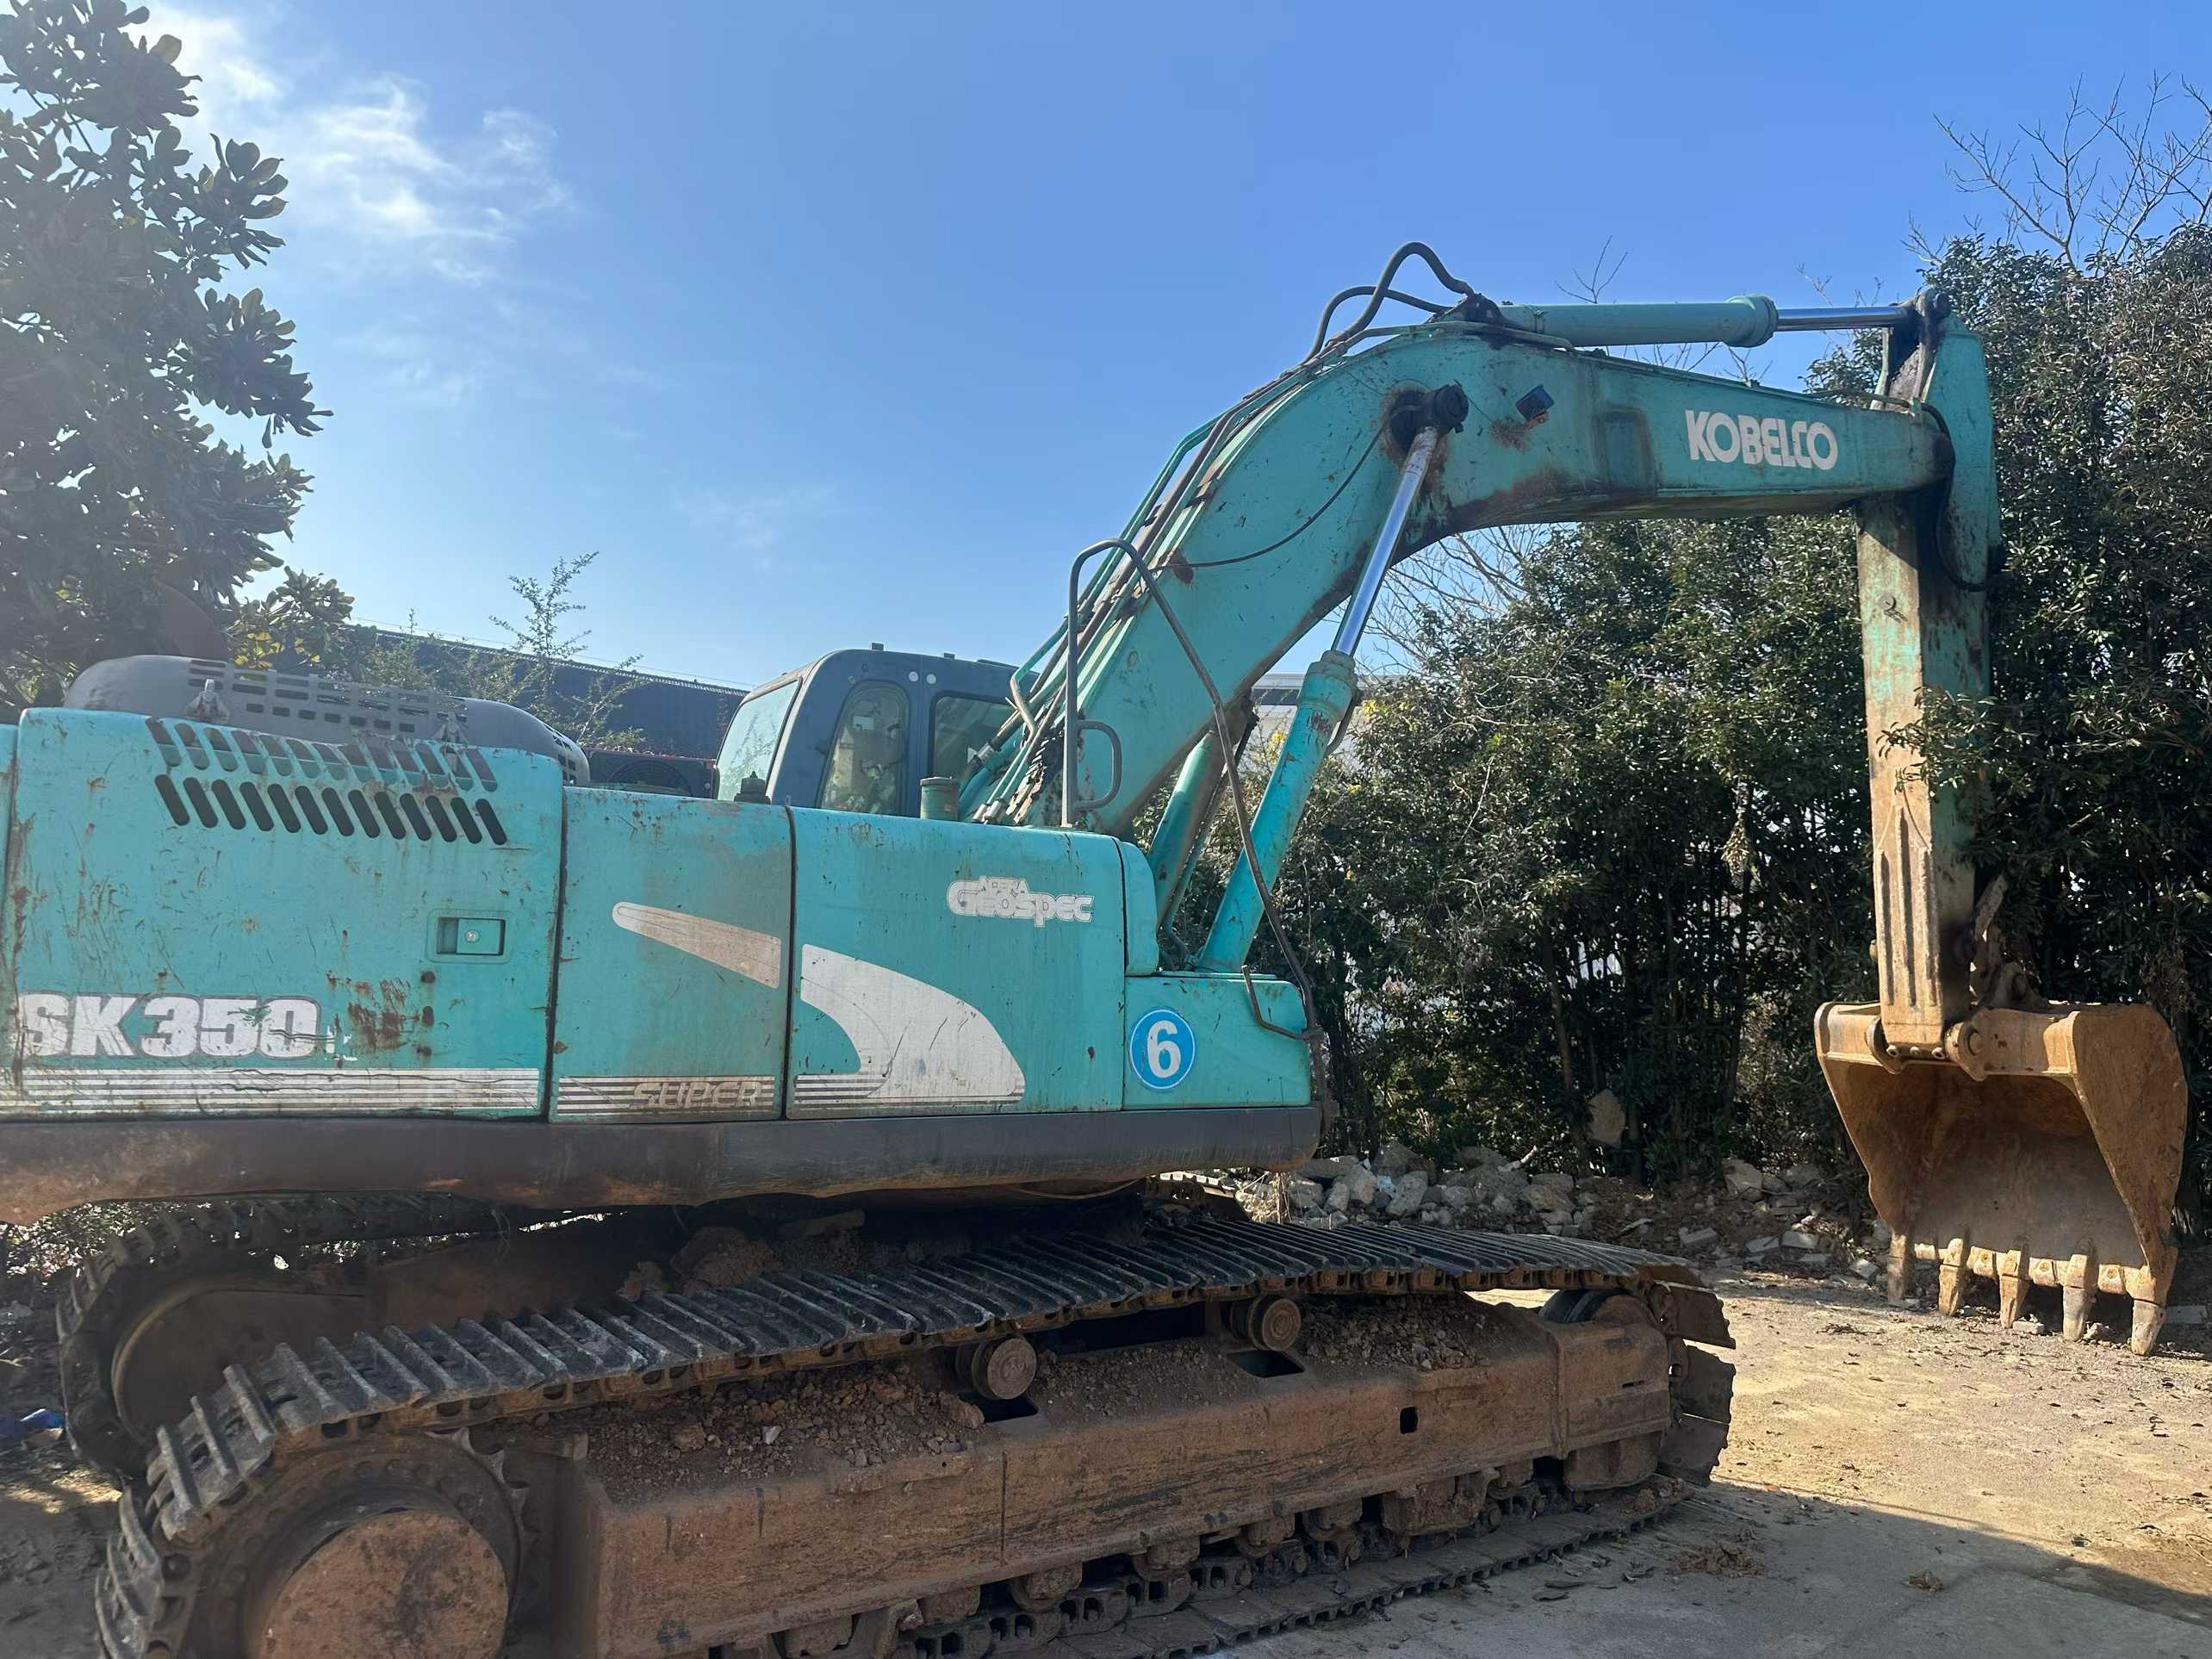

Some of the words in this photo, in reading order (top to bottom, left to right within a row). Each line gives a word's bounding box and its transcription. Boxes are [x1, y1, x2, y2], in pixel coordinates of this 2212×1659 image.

[1686, 409, 1838, 470] KOBELCO
[1147, 1020, 1182, 1078] 6
[629, 1082, 762, 1109] SUPER
